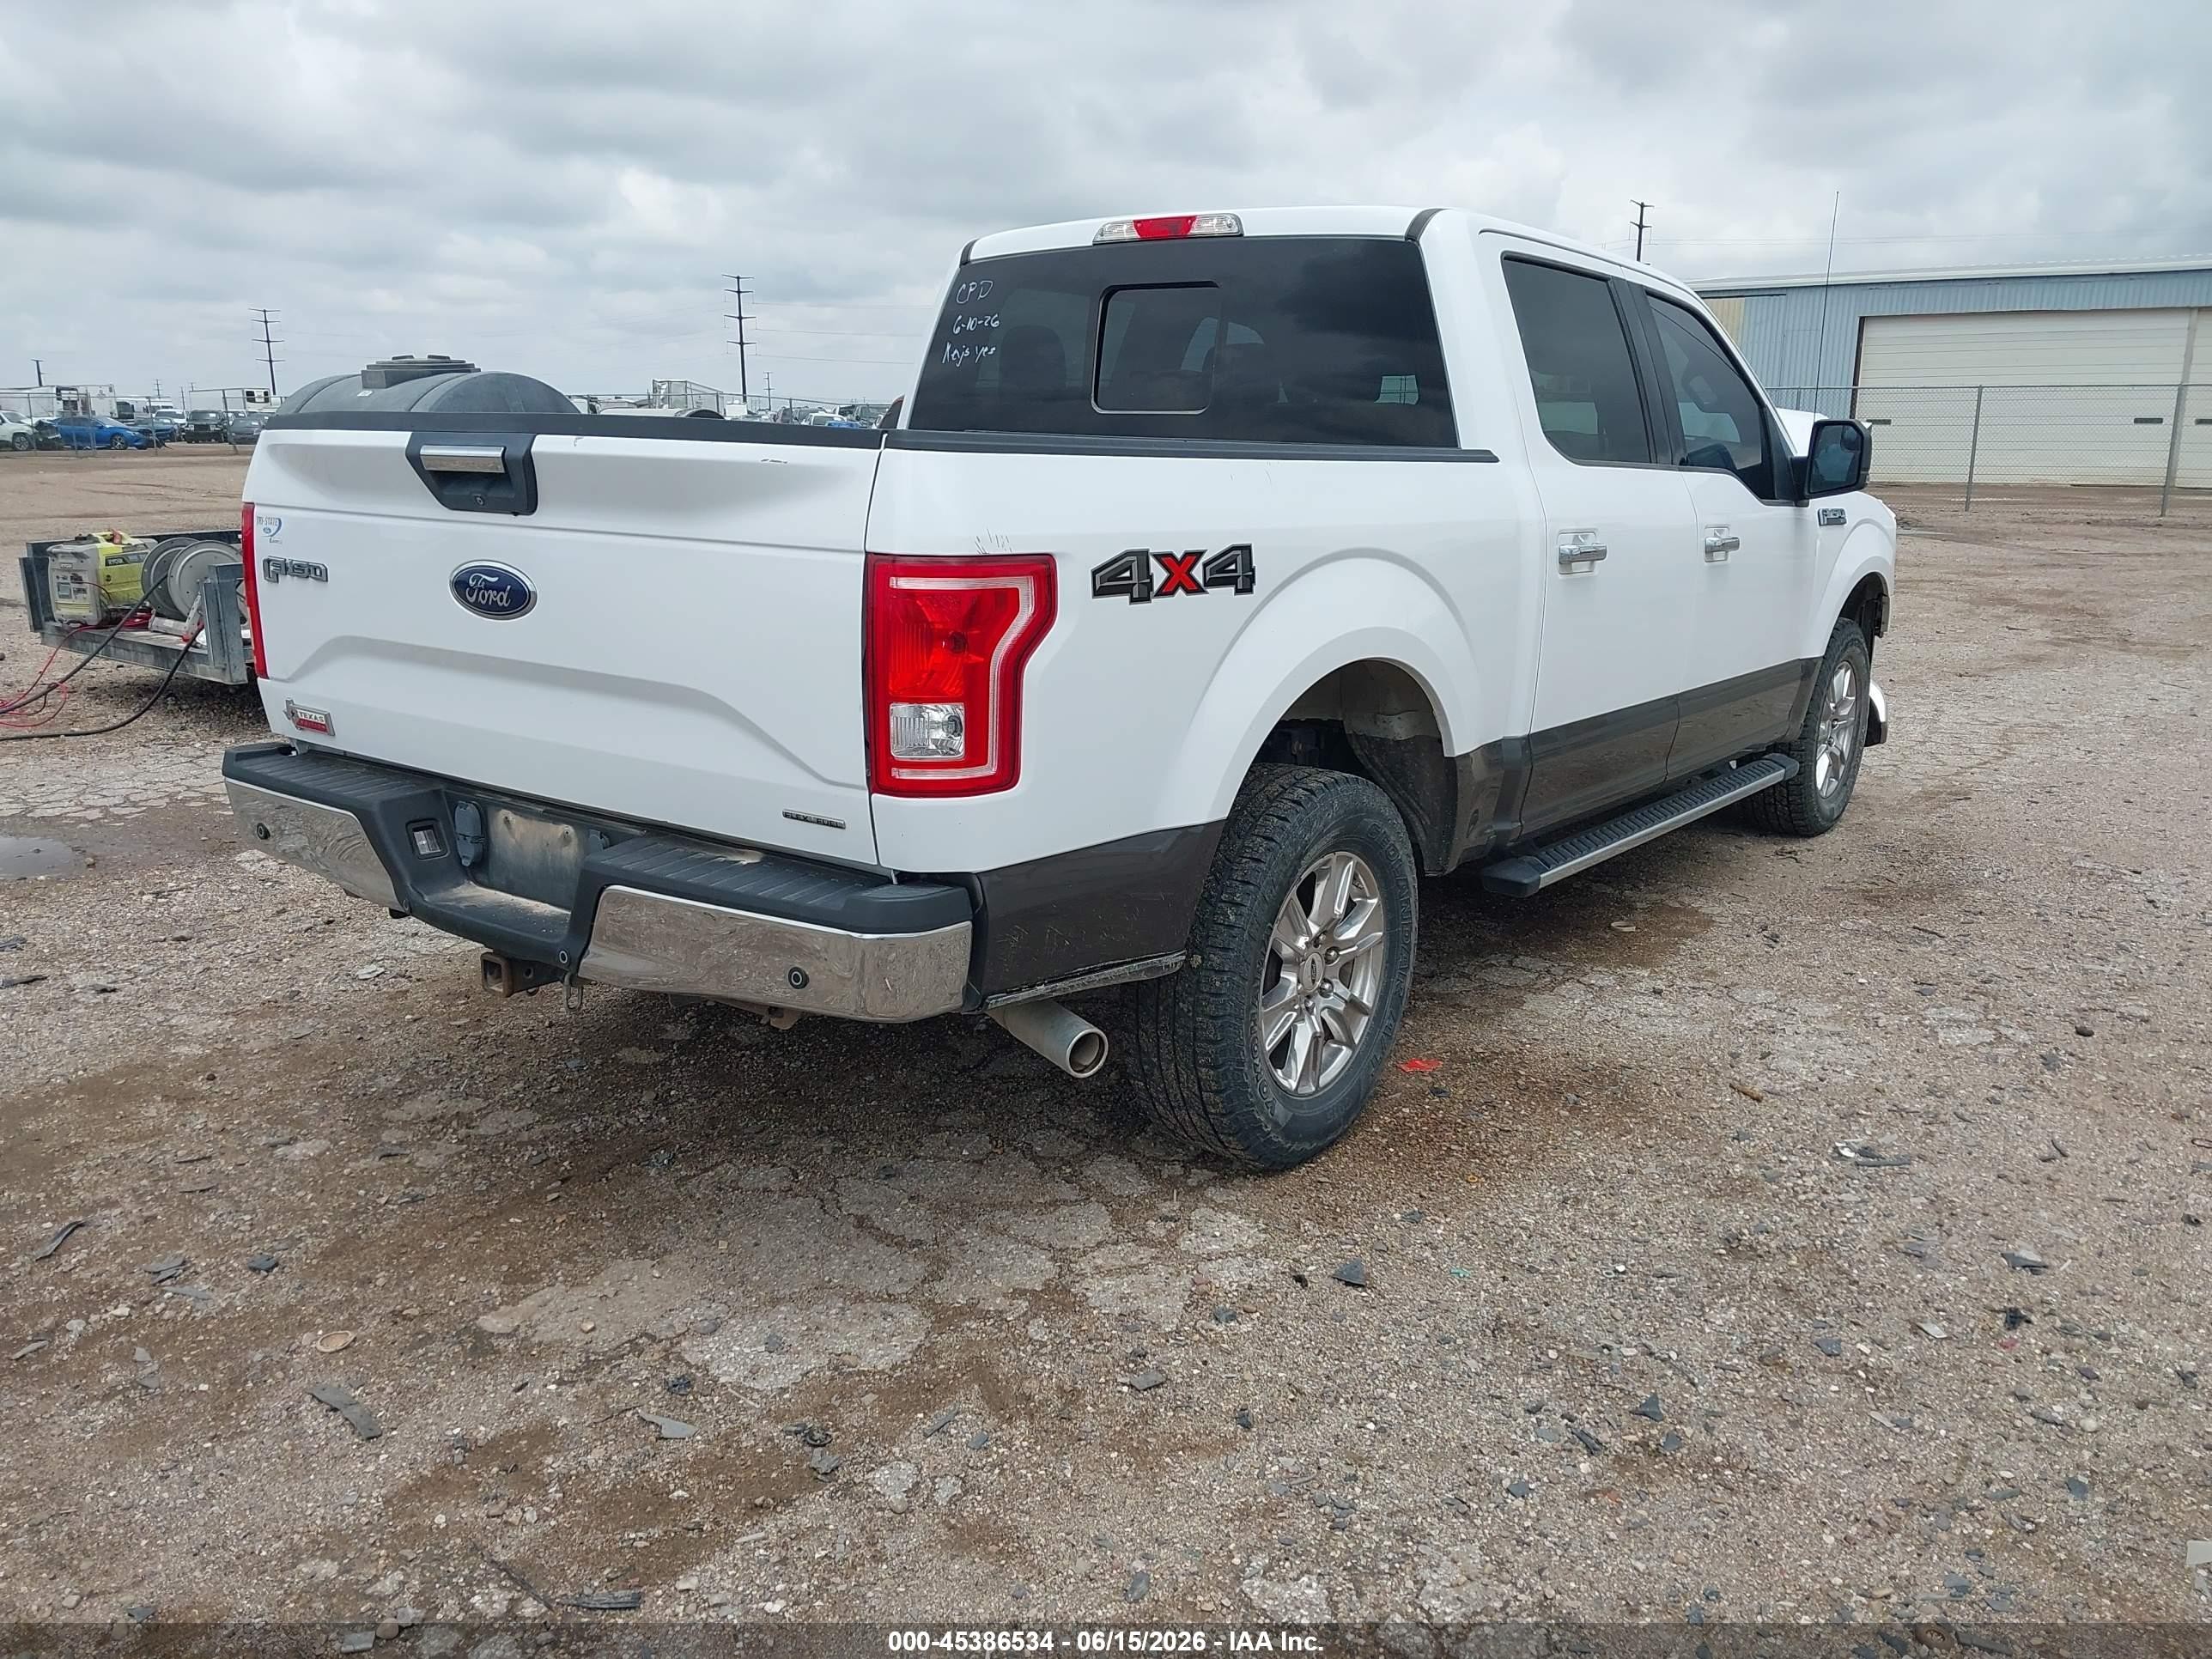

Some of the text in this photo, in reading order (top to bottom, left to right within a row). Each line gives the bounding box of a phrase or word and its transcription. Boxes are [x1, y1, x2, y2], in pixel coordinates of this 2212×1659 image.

[956, 280, 993, 304] CPD
[953, 313, 1000, 334] 6-10-26
[465, 573, 511, 607] Ford
[299, 711, 325, 722] TEXAS
[784, 811, 843, 829] FLEX FUEL
